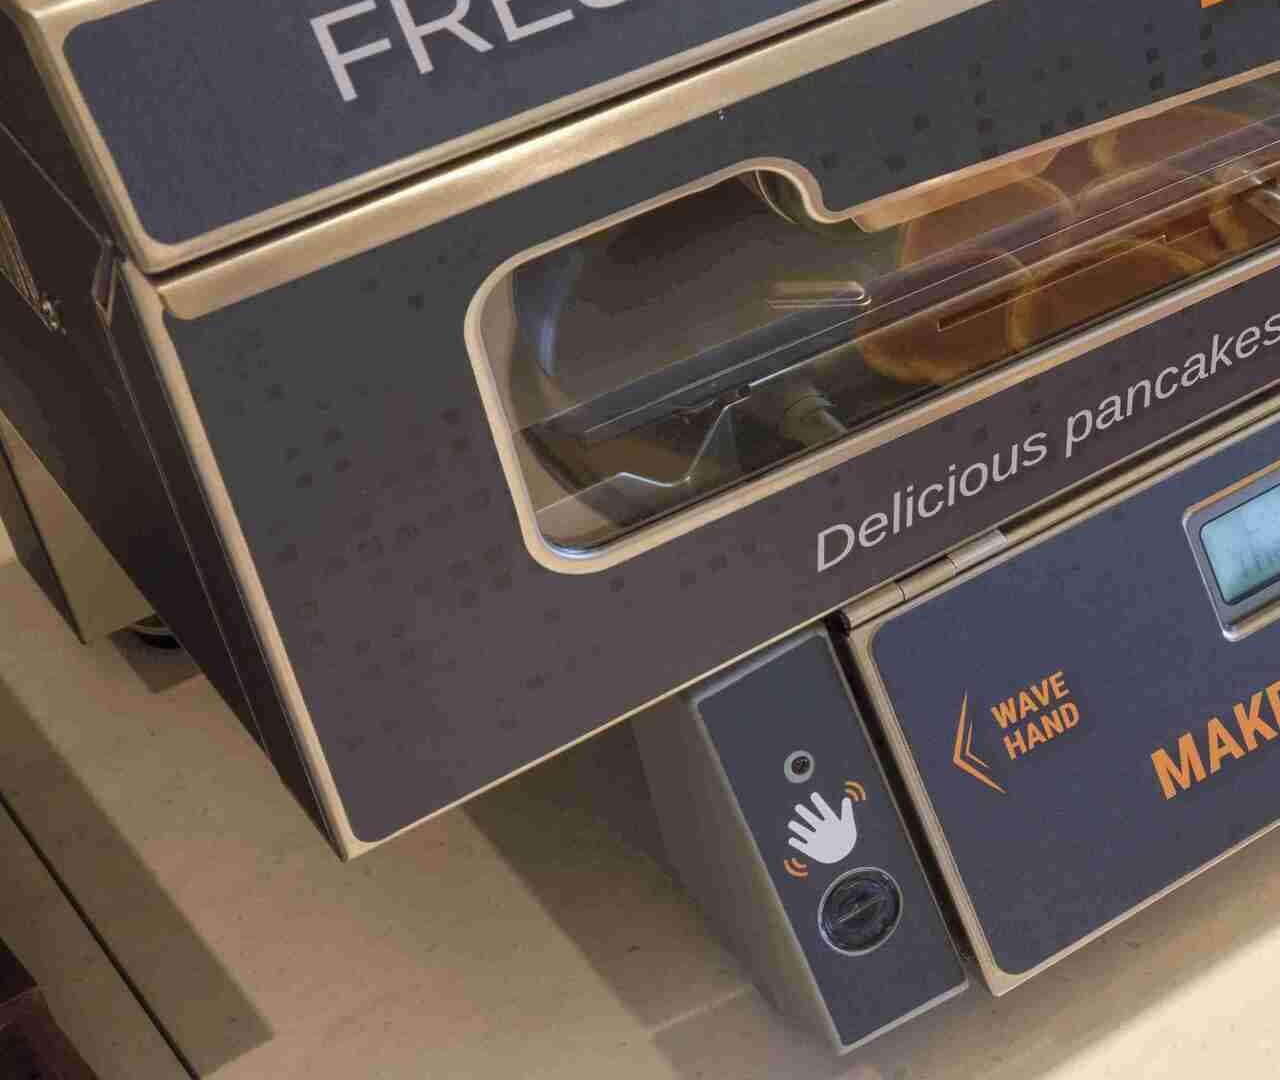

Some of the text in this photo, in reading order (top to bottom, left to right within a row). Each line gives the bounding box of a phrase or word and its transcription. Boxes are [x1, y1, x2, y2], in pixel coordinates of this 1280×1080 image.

[815, 429, 1049, 573] Delicious
[990, 671, 1070, 730] WAVE
[1003, 701, 1081, 761] HAND
